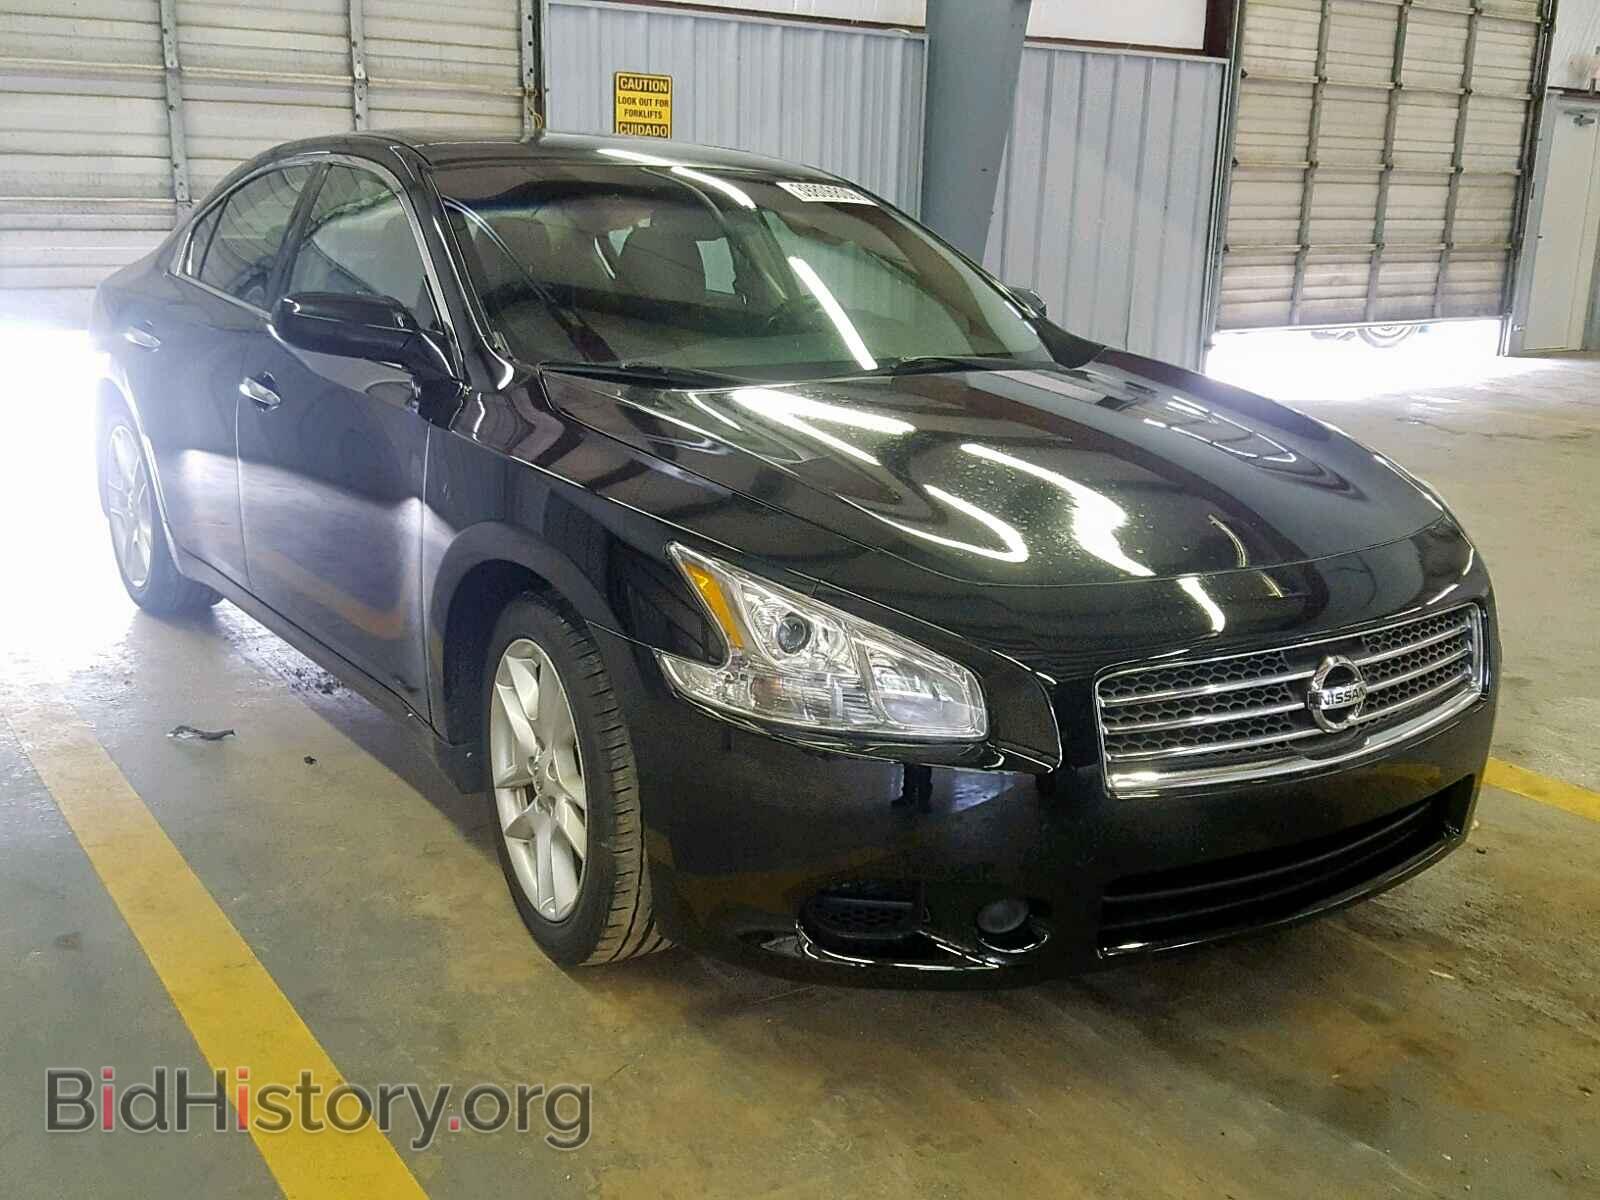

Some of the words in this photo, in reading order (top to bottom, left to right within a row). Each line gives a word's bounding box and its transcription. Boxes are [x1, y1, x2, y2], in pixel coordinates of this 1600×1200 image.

[620, 78, 667, 92] CAUTION
[618, 96, 637, 105] LOOK
[639, 98, 652, 106] OUT
[655, 99, 669, 107] FOR
[624, 109, 663, 119] FORKLIFTS
[619, 123, 667, 137] CUIDADO
[1319, 686, 1367, 706] NISSAN
